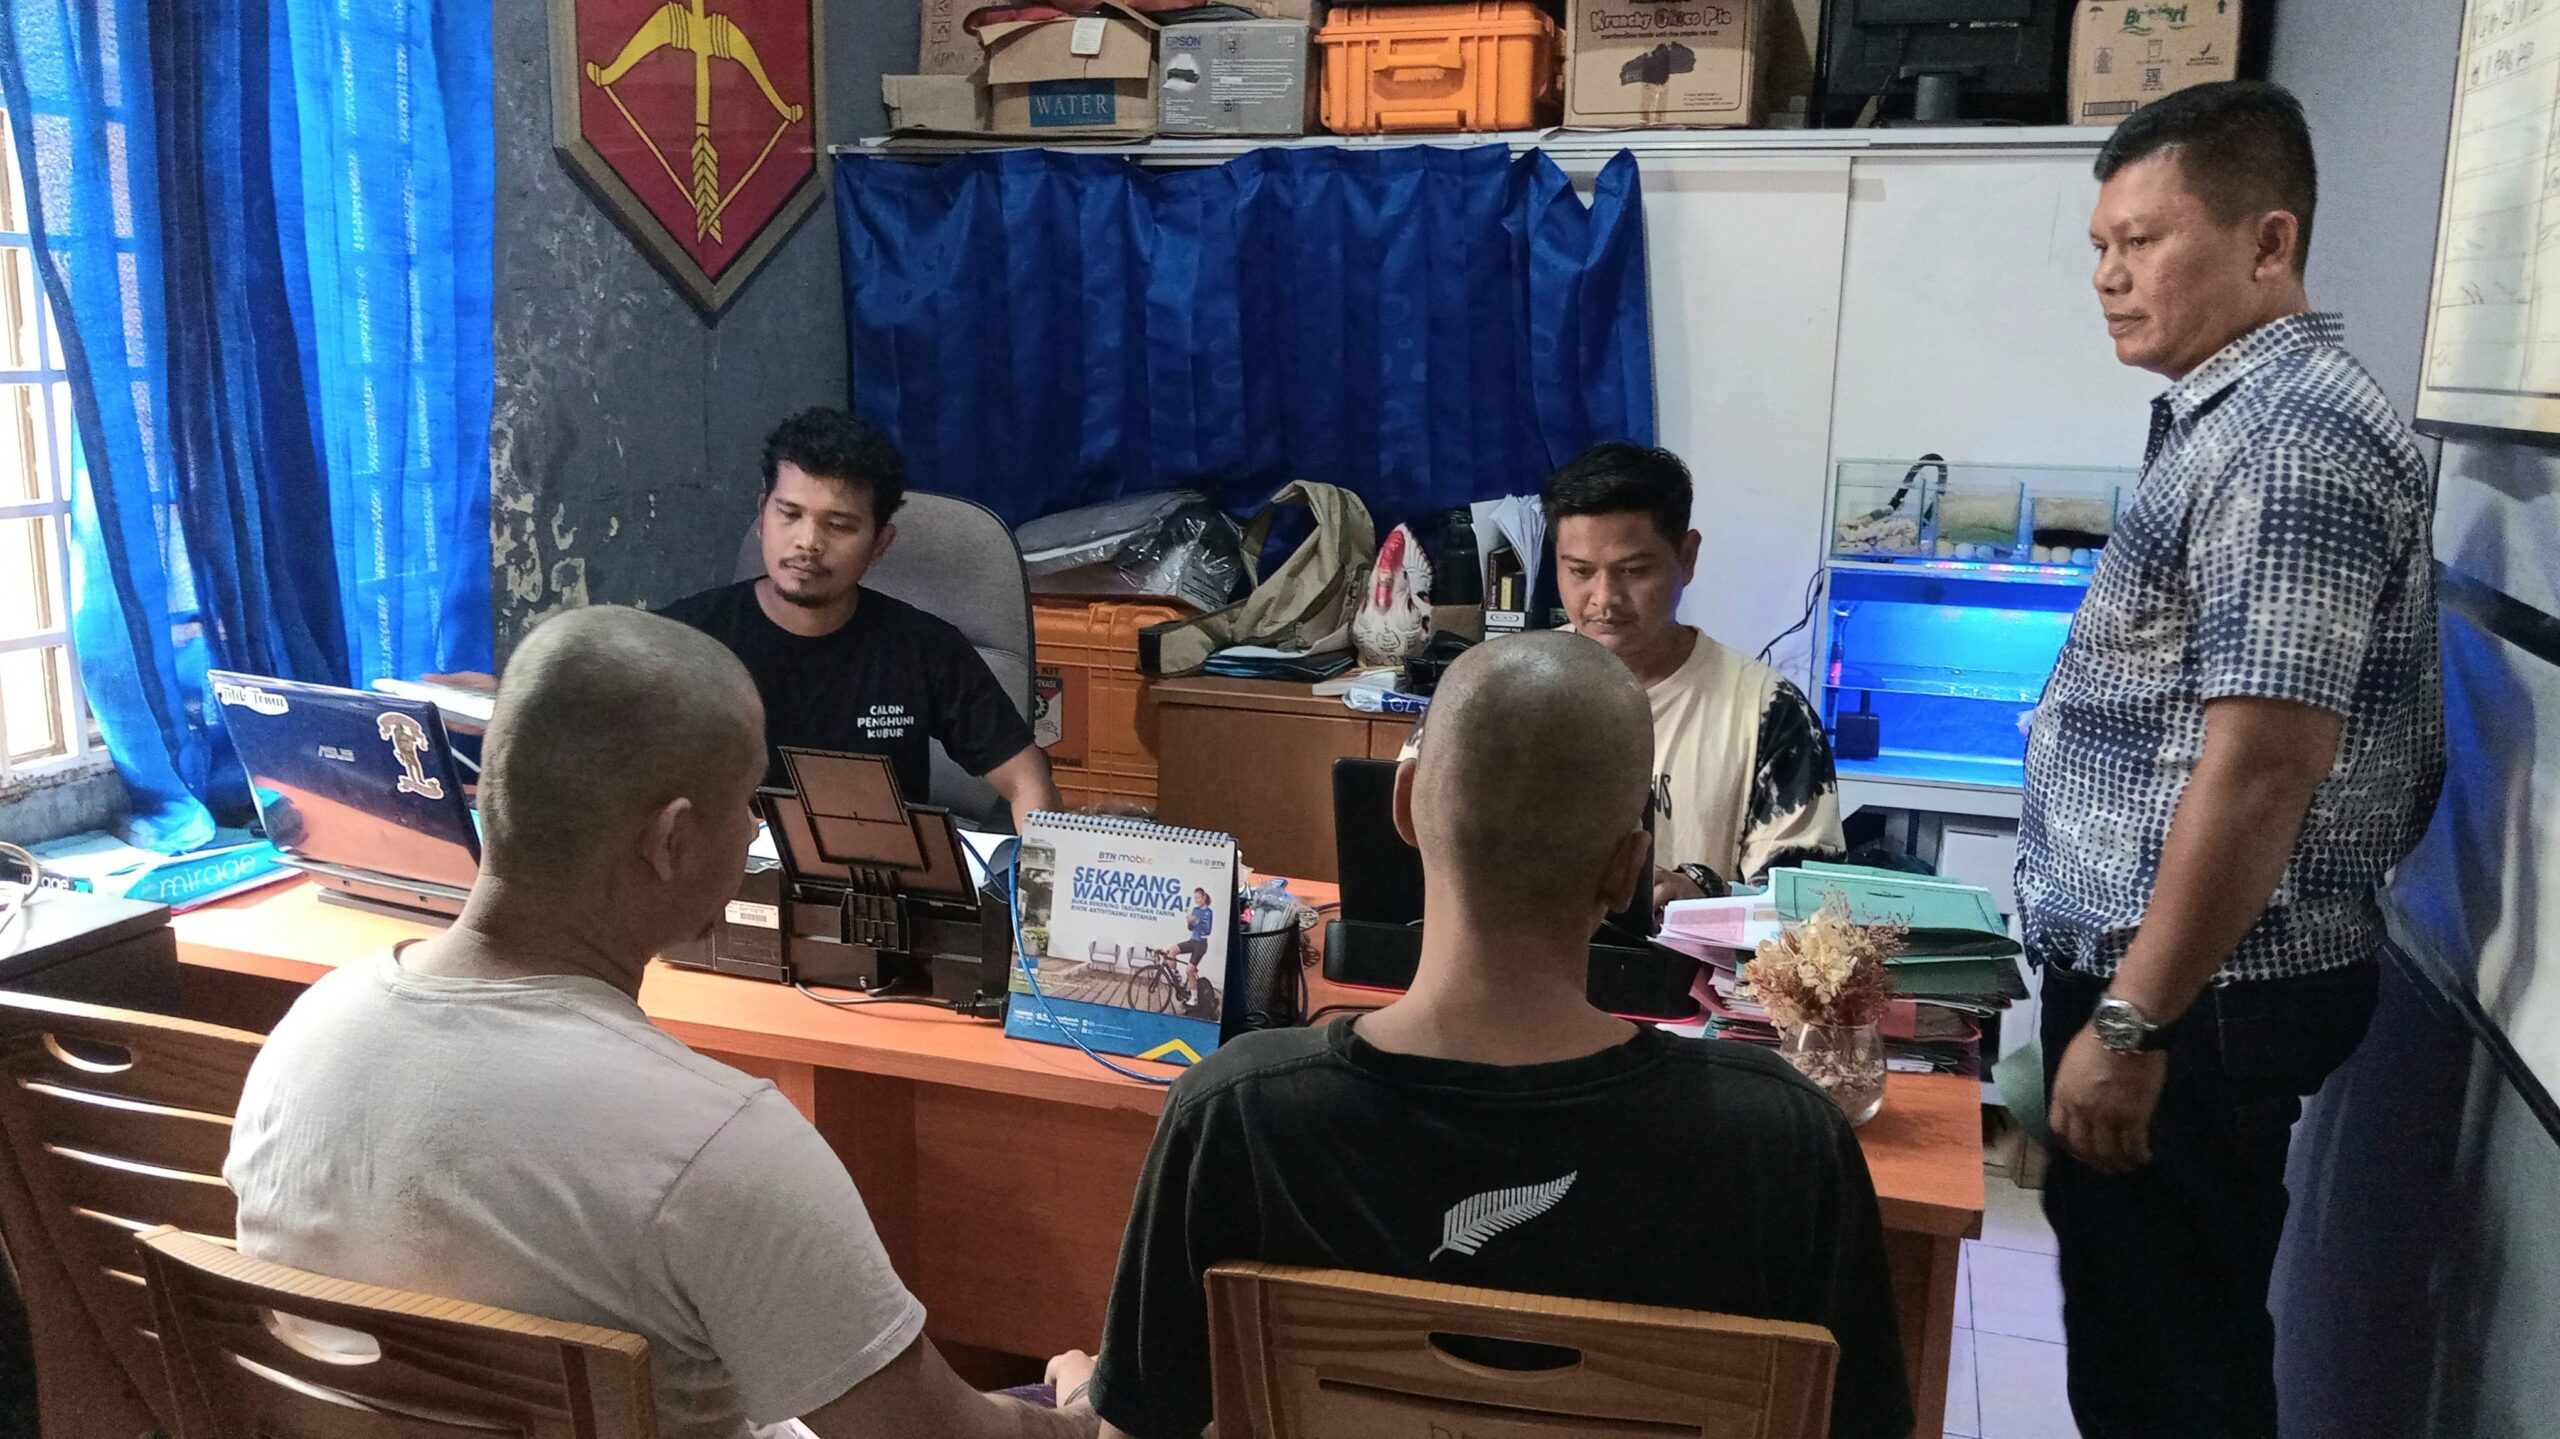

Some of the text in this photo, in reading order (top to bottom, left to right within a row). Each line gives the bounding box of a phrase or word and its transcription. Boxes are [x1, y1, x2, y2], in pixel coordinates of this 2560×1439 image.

[1166, 36, 1201, 47] EPSON
[1036, 95, 1109, 115] WATER
[869, 704, 904, 716] CALON
[857, 716, 915, 728] PENGHUNI
[867, 728, 904, 739] KUBUR
[1099, 851, 1117, 861] BTN
[161, 853, 257, 899] mirage
[1073, 866, 1181, 895] SEKARANG
[1073, 882, 1192, 913] WAKTUNYA!
